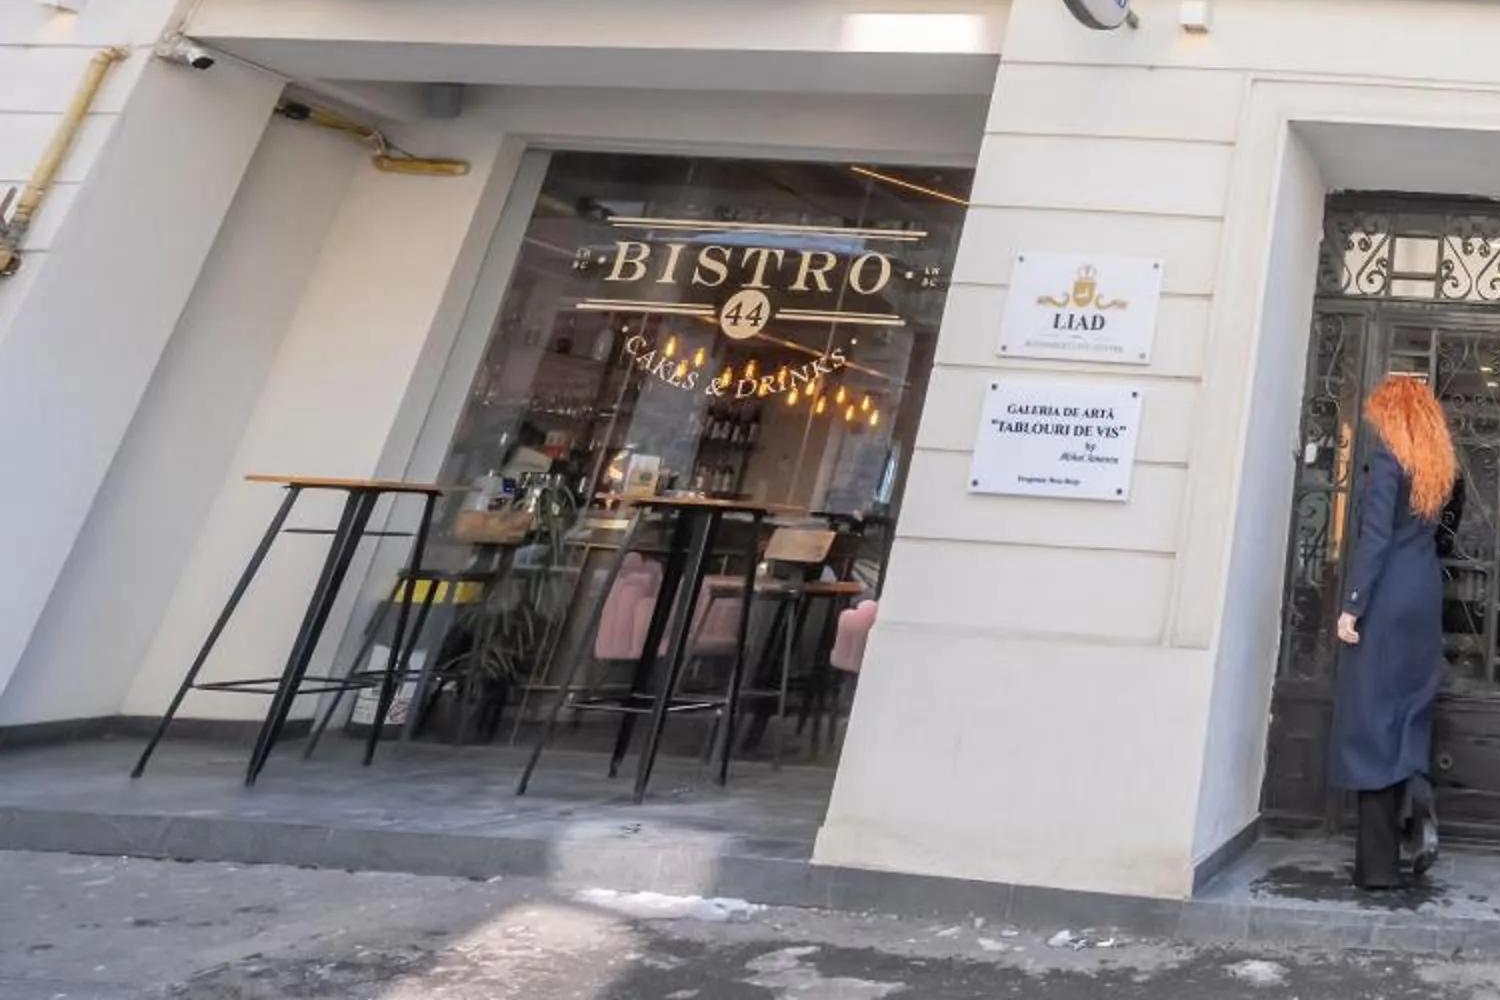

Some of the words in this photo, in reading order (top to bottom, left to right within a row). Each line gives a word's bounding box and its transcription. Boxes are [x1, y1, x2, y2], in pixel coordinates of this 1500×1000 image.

[604, 241, 891, 295] BISTRO
[724, 301, 763, 327] 44
[1053, 313, 1106, 331] LIAD
[626, 335, 699, 390] CAKES
[705, 377, 725, 396] &
[735, 348, 846, 399] DRINKS
[1007, 403, 1061, 417] GALERIA
[1063, 407, 1080, 417] DE
[1073, 425, 1093, 437] DE
